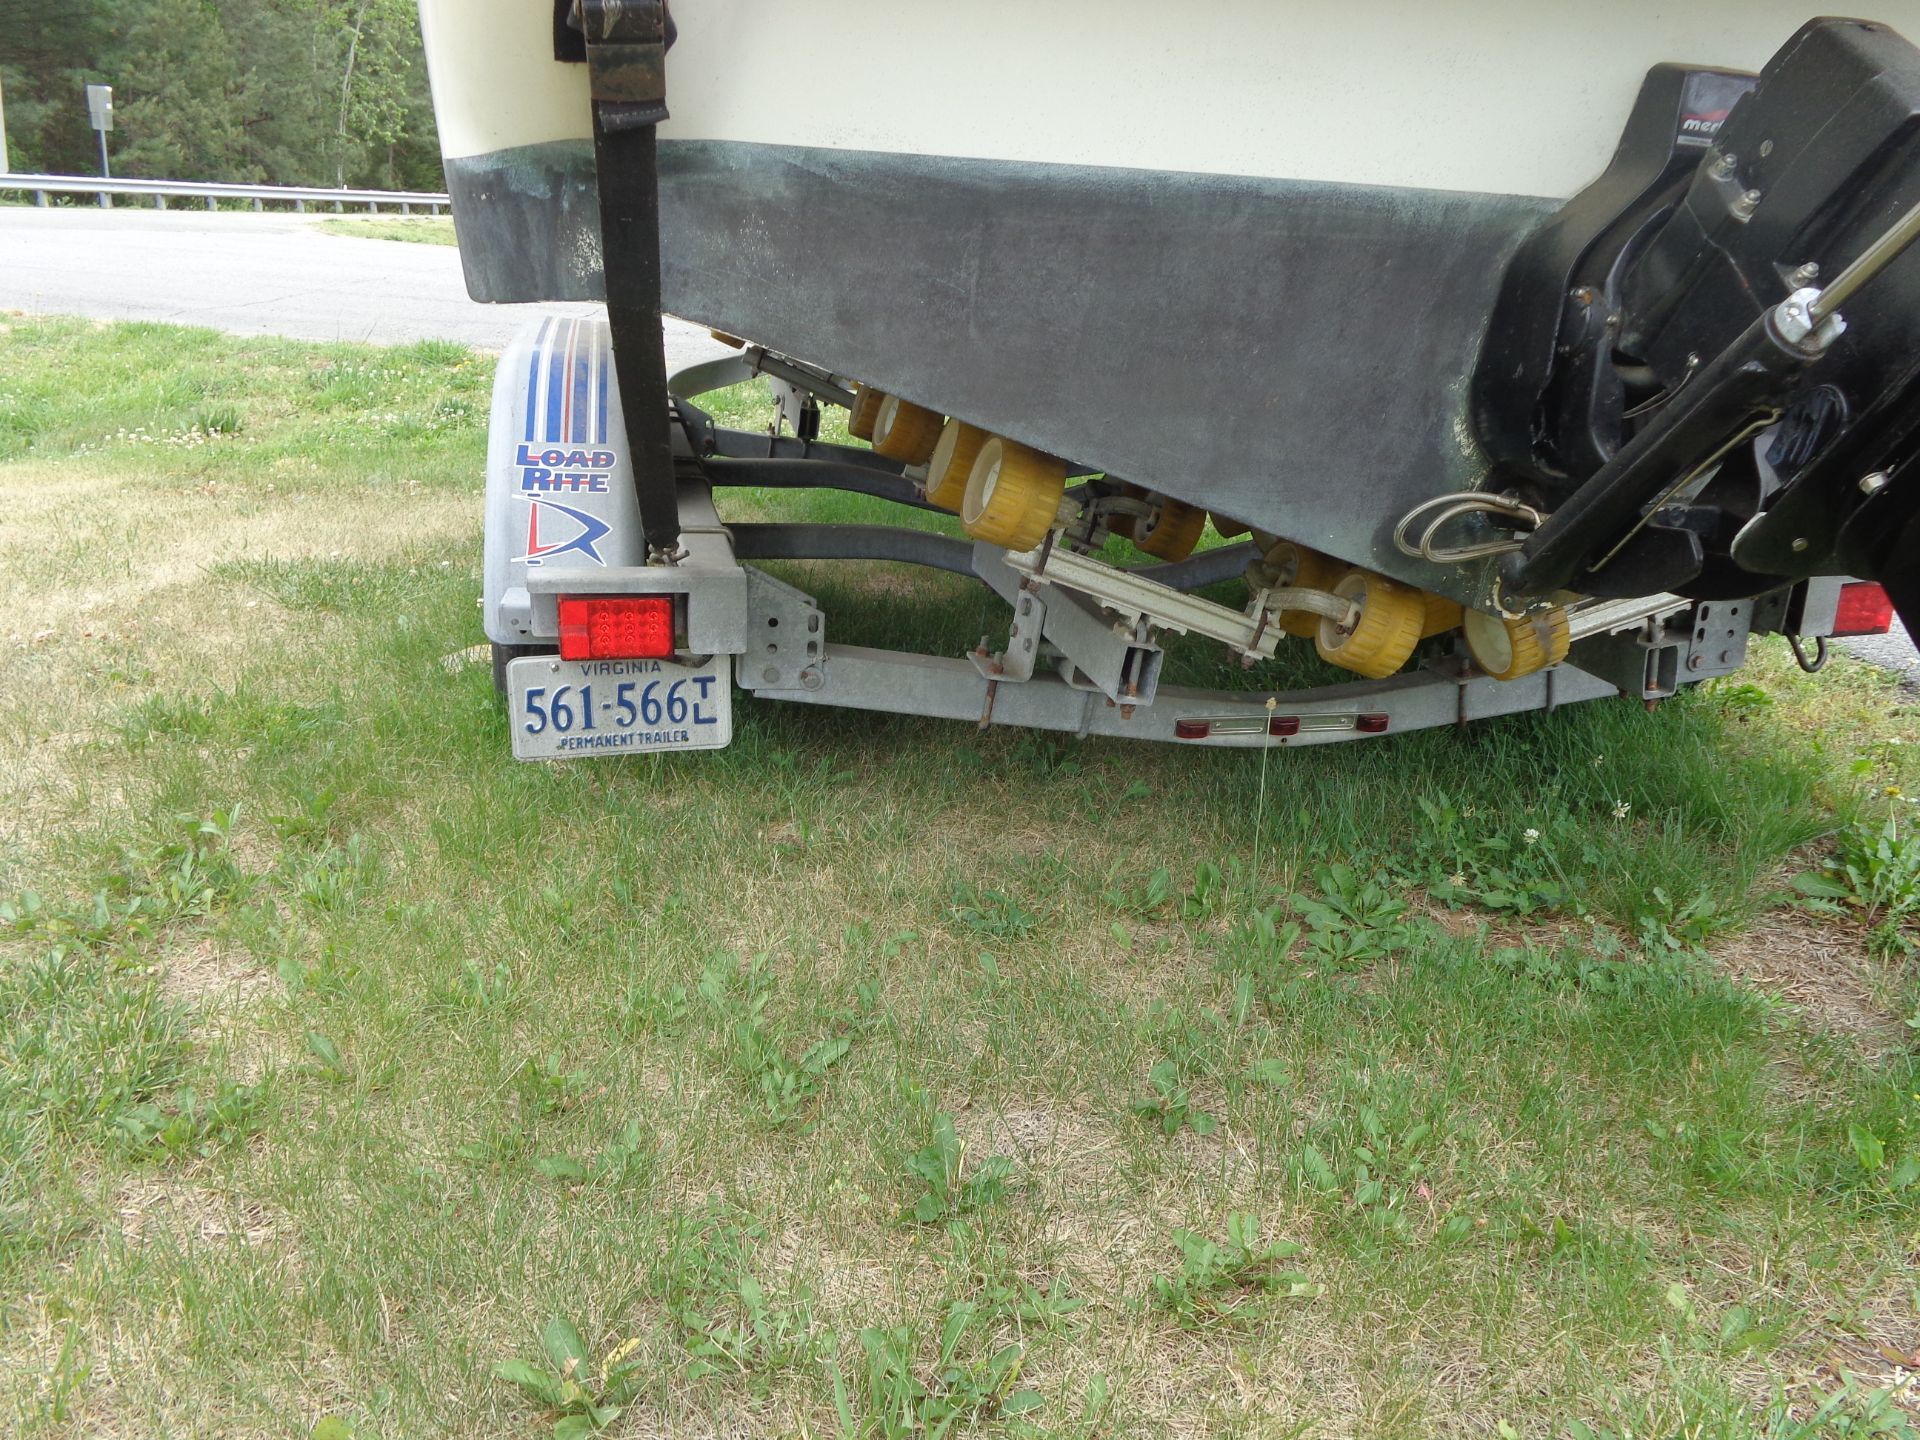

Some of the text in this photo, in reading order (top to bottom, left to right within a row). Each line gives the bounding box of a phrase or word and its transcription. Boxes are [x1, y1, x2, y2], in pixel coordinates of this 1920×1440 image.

[515, 444, 616, 469] LOAD
[521, 467, 610, 493] RITE
[580, 660, 662, 677] VIRGINIA
[560, 729, 689, 750] PERMANENT TRAILER
